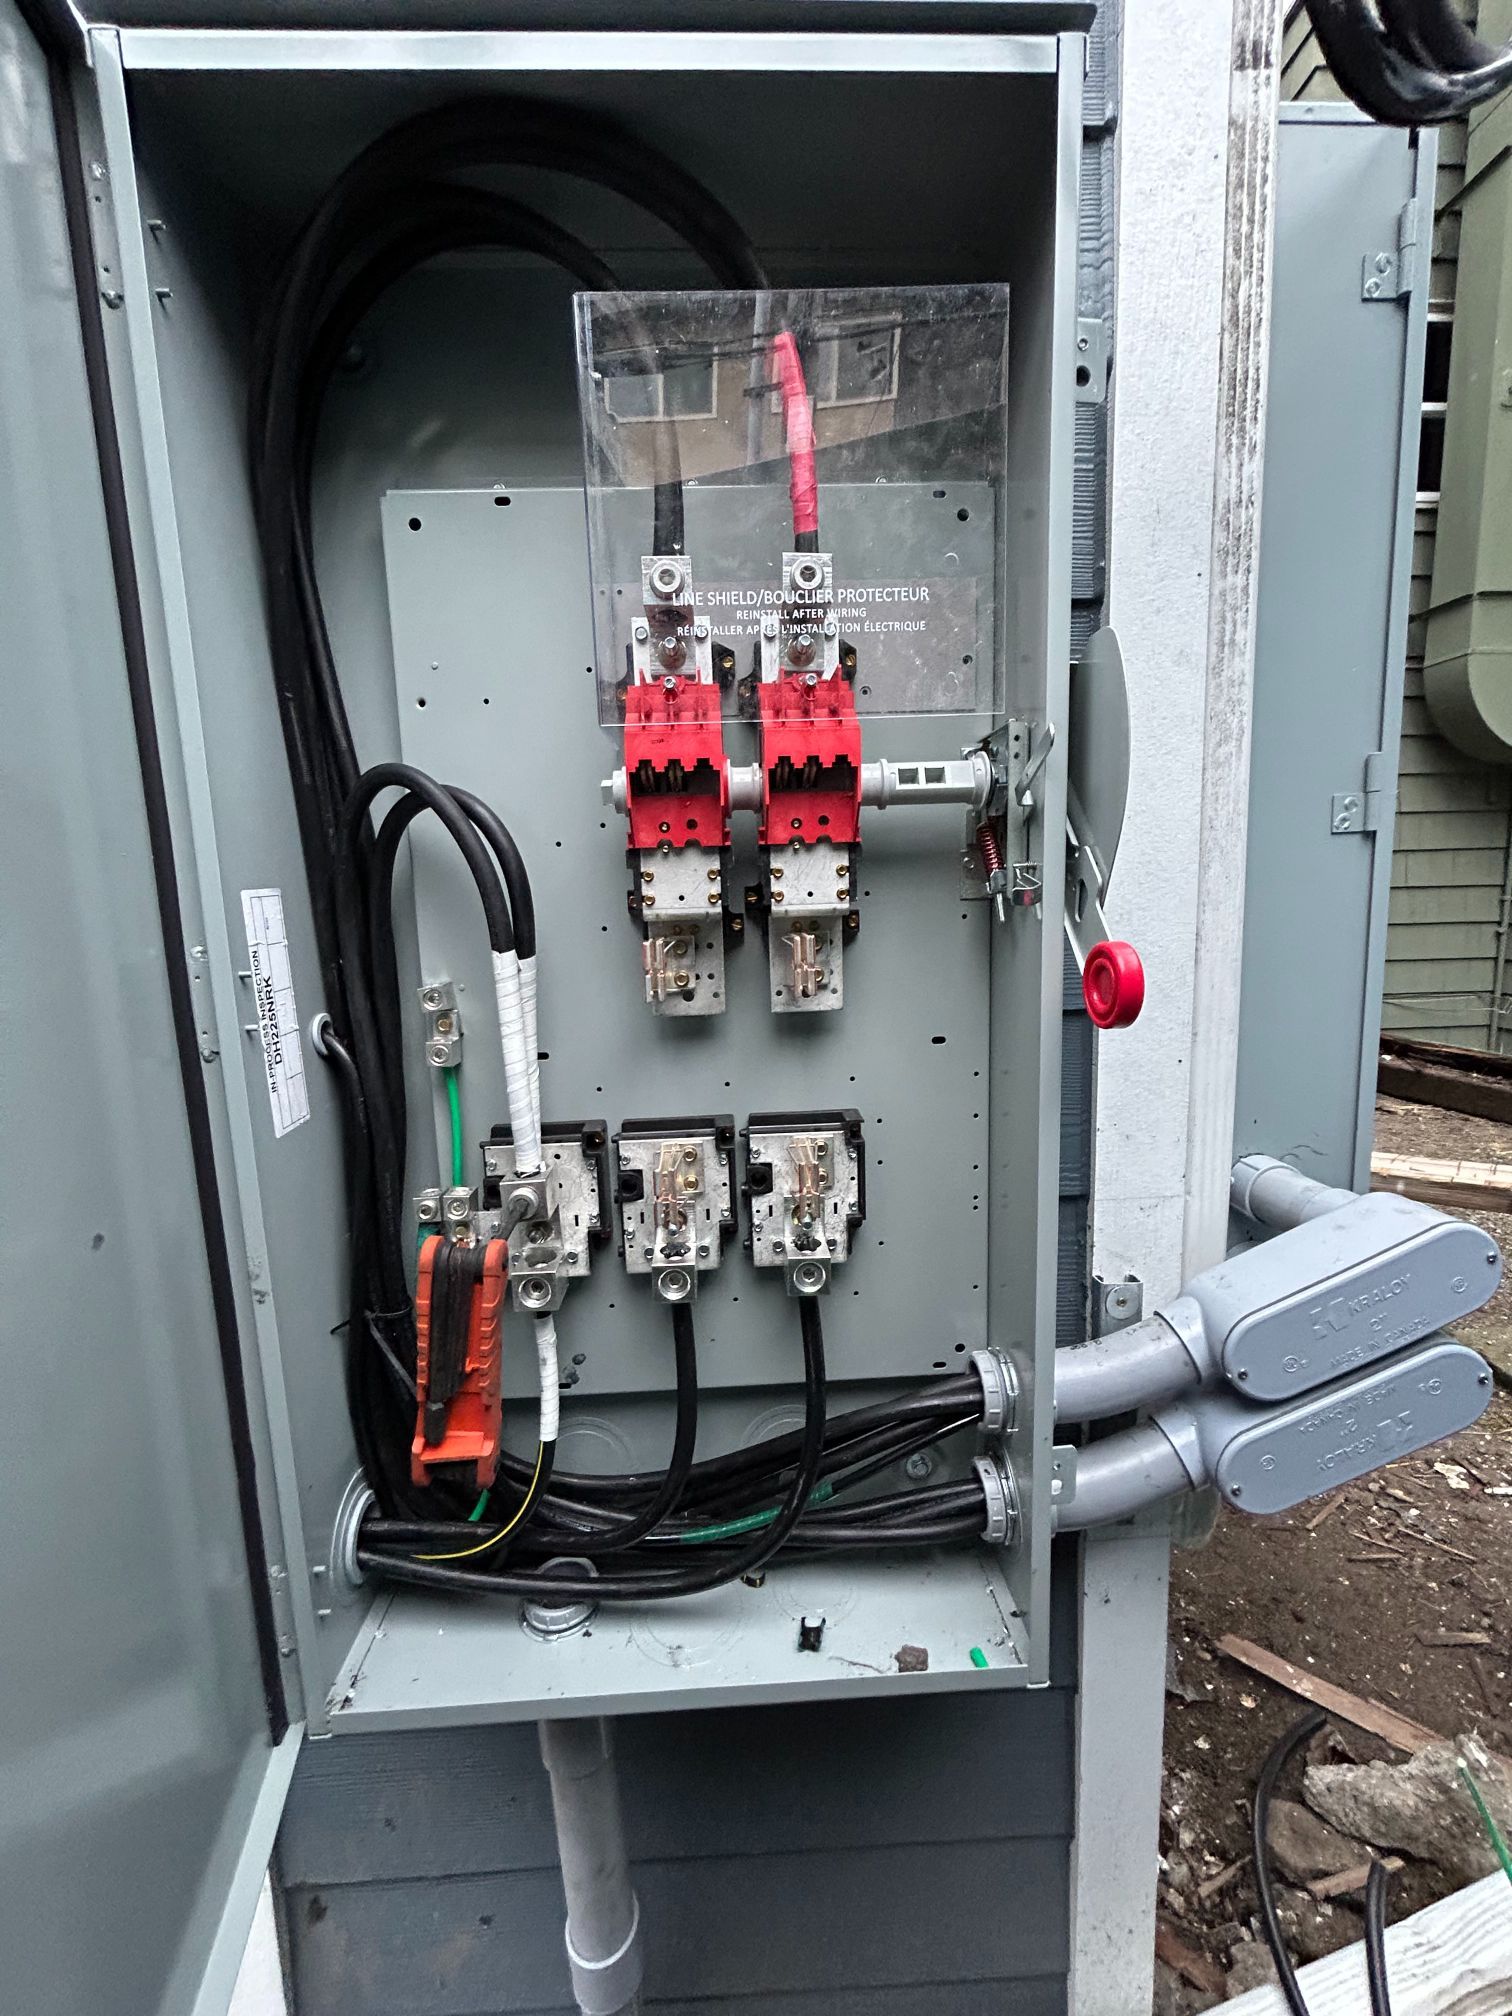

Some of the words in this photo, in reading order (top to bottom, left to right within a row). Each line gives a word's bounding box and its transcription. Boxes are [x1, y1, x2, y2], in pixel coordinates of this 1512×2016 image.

[672, 591, 705, 606] LINE
[707, 589, 834, 607] SHIELD/BOUCLIER
[838, 587, 930, 604] PROTECTEUR
[736, 609, 790, 620] REINSTALL
[792, 608, 824, 619] AFTER
[827, 607, 867, 618] WIRING
[677, 623, 743, 637] RÉINSTALLER
[745, 622, 780, 635] APRÈS
[781, 621, 861, 634] L'INSTALLATION
[864, 619, 927, 633] ÉLECTRIQUE
[251, 950, 267, 1020] INSPECTION
[263, 975, 283, 1065] DH225NRK
[262, 1023, 278, 1093] IN-PROCESS
[1347, 1272, 1411, 1317] KRALOY
